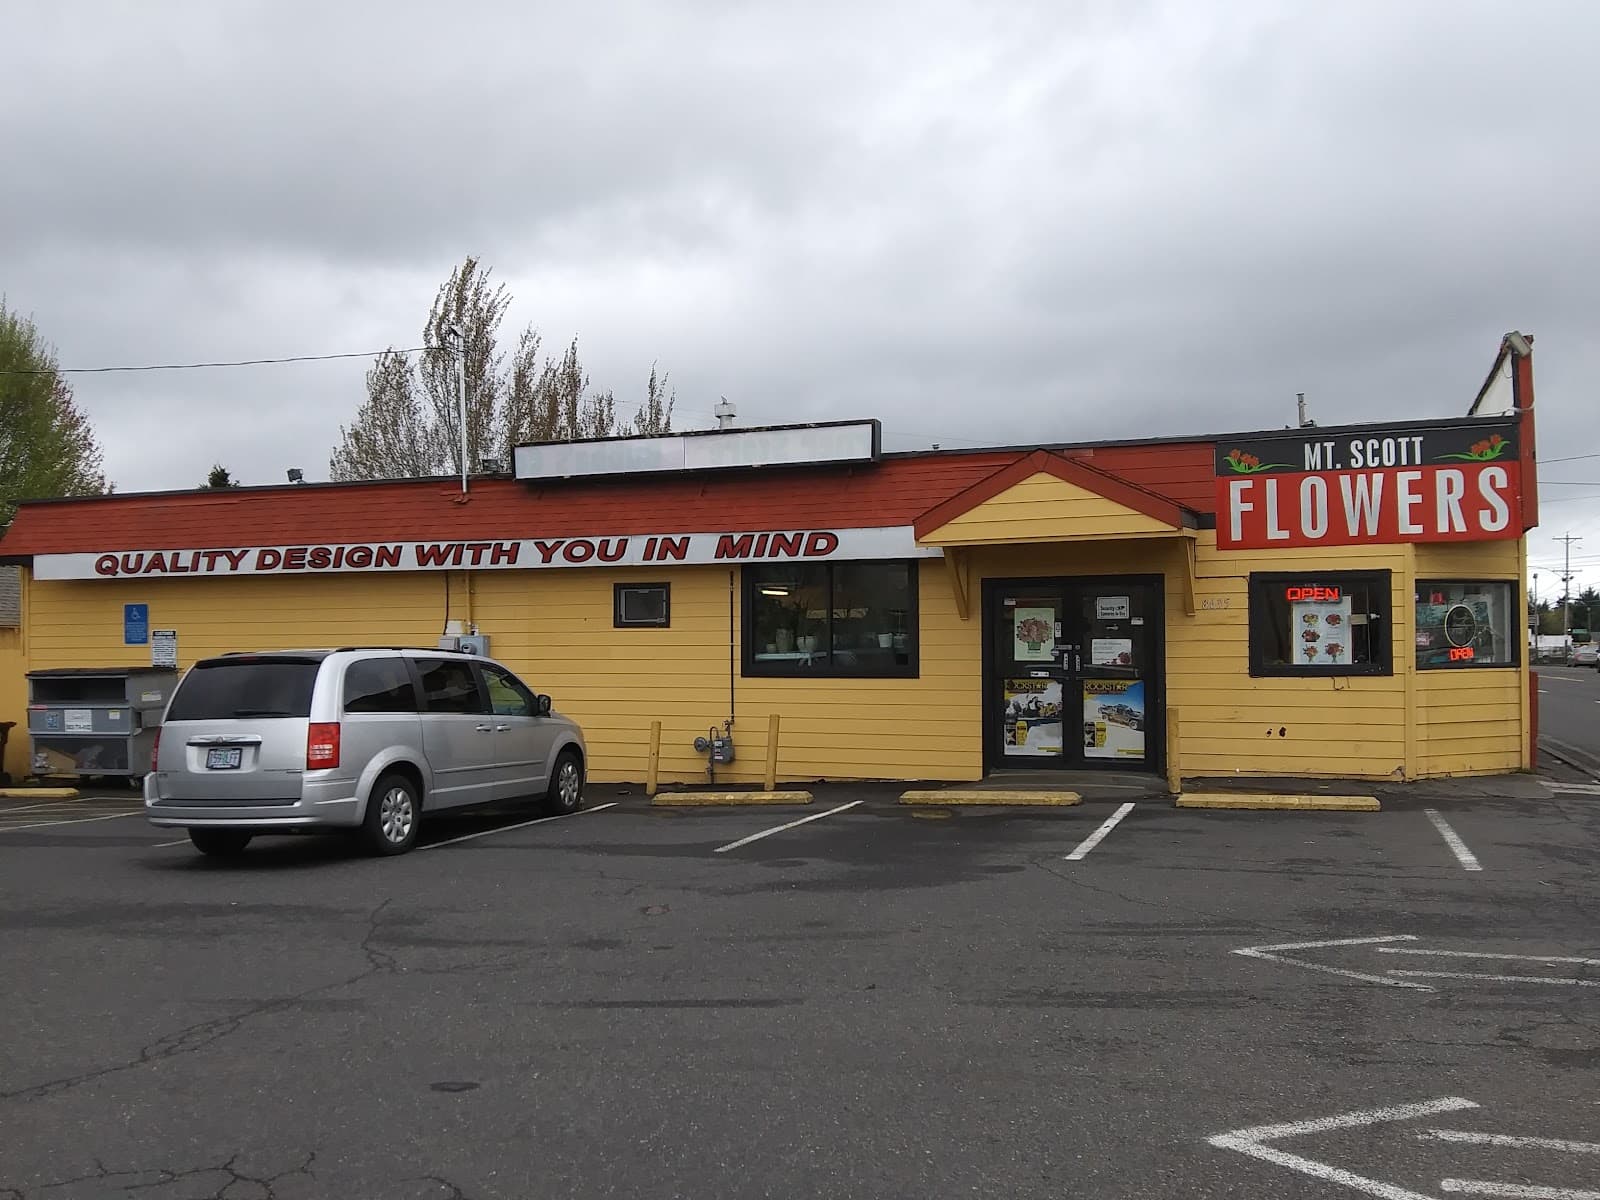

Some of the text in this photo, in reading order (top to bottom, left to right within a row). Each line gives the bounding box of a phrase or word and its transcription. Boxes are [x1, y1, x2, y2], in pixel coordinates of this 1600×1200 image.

[1304, 436, 1424, 471] MT. SCOTT
[1229, 466, 1509, 542] FLOWERS
[95, 531, 840, 576] QUALITY DESIGN WITH YOU IN MIND
[1286, 587, 1339, 601] OPEN
[1450, 647, 1475, 661] OPEN
